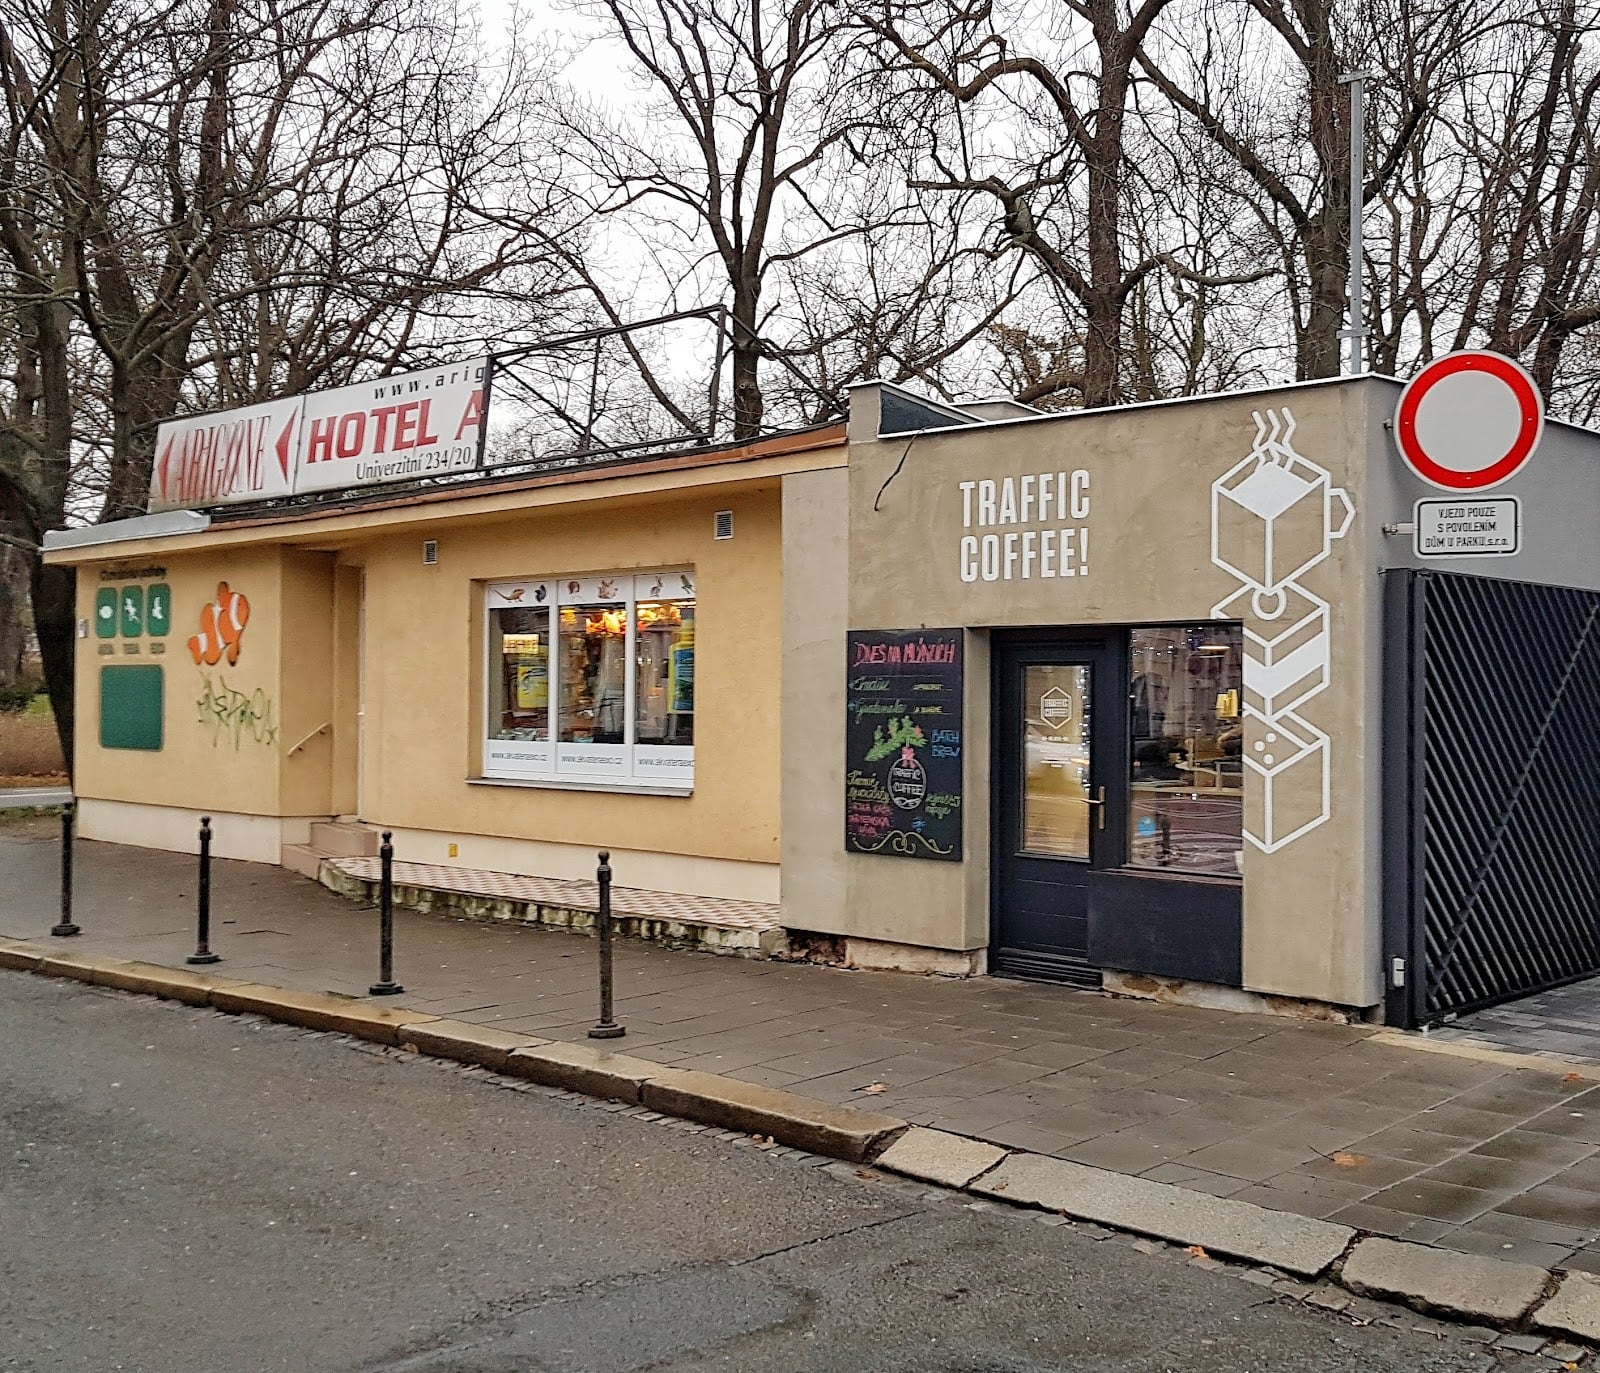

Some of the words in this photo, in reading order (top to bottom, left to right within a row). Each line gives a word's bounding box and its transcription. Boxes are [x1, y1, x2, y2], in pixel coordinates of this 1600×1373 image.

[306, 398, 438, 464] HOTEL
[356, 453, 425, 480] Univerzitní
[959, 469, 1090, 528] TRAFFIC
[1438, 508, 1465, 519] VJEZD
[1467, 506, 1497, 518] POUZE
[1437, 523, 1445, 533] S
[1446, 519, 1497, 533] POVOLENÍM
[1425, 535, 1445, 548] DŮM
[1447, 537, 1453, 547] U
[960, 527, 1090, 583] COFFEE!
[931, 745, 961, 758] BREW
